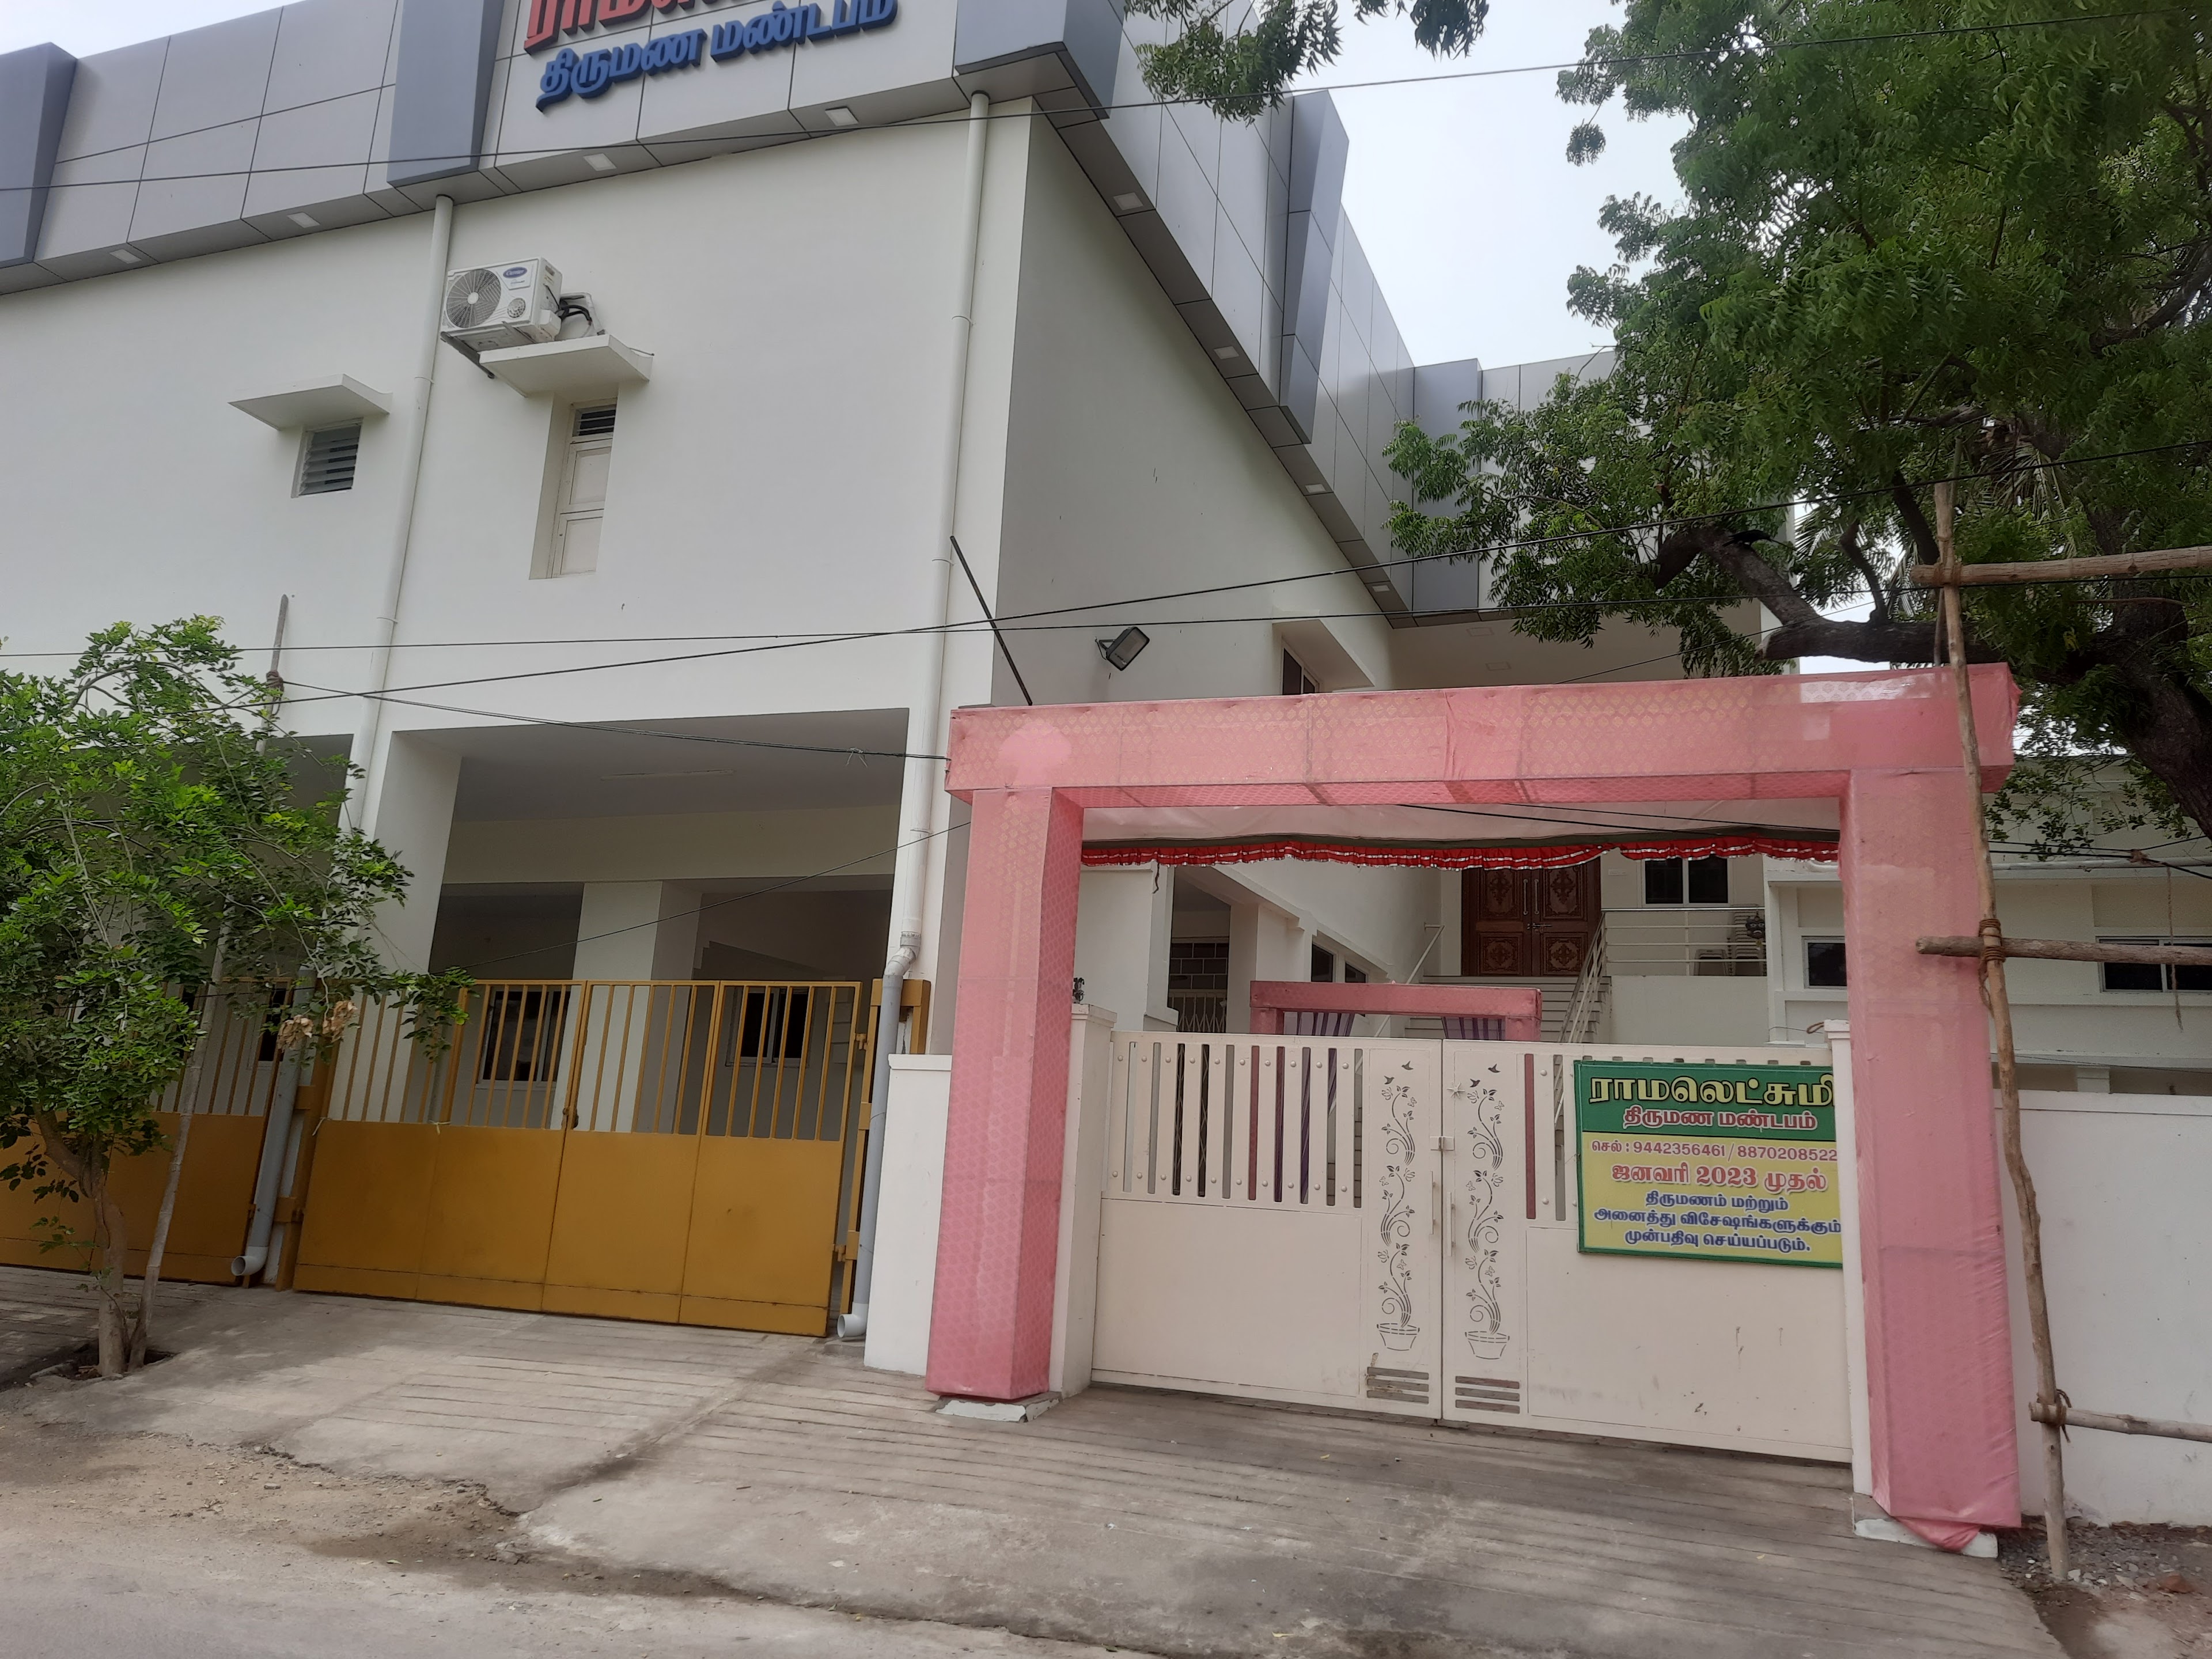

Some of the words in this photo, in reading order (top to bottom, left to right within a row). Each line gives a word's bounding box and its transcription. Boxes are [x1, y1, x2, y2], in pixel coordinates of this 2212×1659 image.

[535, 29, 707, 112] திருமண
[1589, 1074, 1834, 1107] ராமலெட்சுமி
[1623, 1105, 1714, 1128] திருமண
[1719, 1109, 1816, 1130] மண்டபம்
[1612, 1162, 1688, 1183] ஜனவரி
[1696, 1166, 1757, 1186] 2023
[1764, 1168, 1827, 1192] முதல்
[1646, 1190, 1727, 1207] திருமணம்
[1732, 1195, 1789, 1213] மற்றும்
[1594, 1209, 1676, 1228] அனைத்து
[1680, 1211, 1841, 1234] விசேஷங்களுக்கும்
[1625, 1229, 1699, 1247] முன்பதிவு
[1703, 1233, 1810, 1253] செய்யப்படும்.
